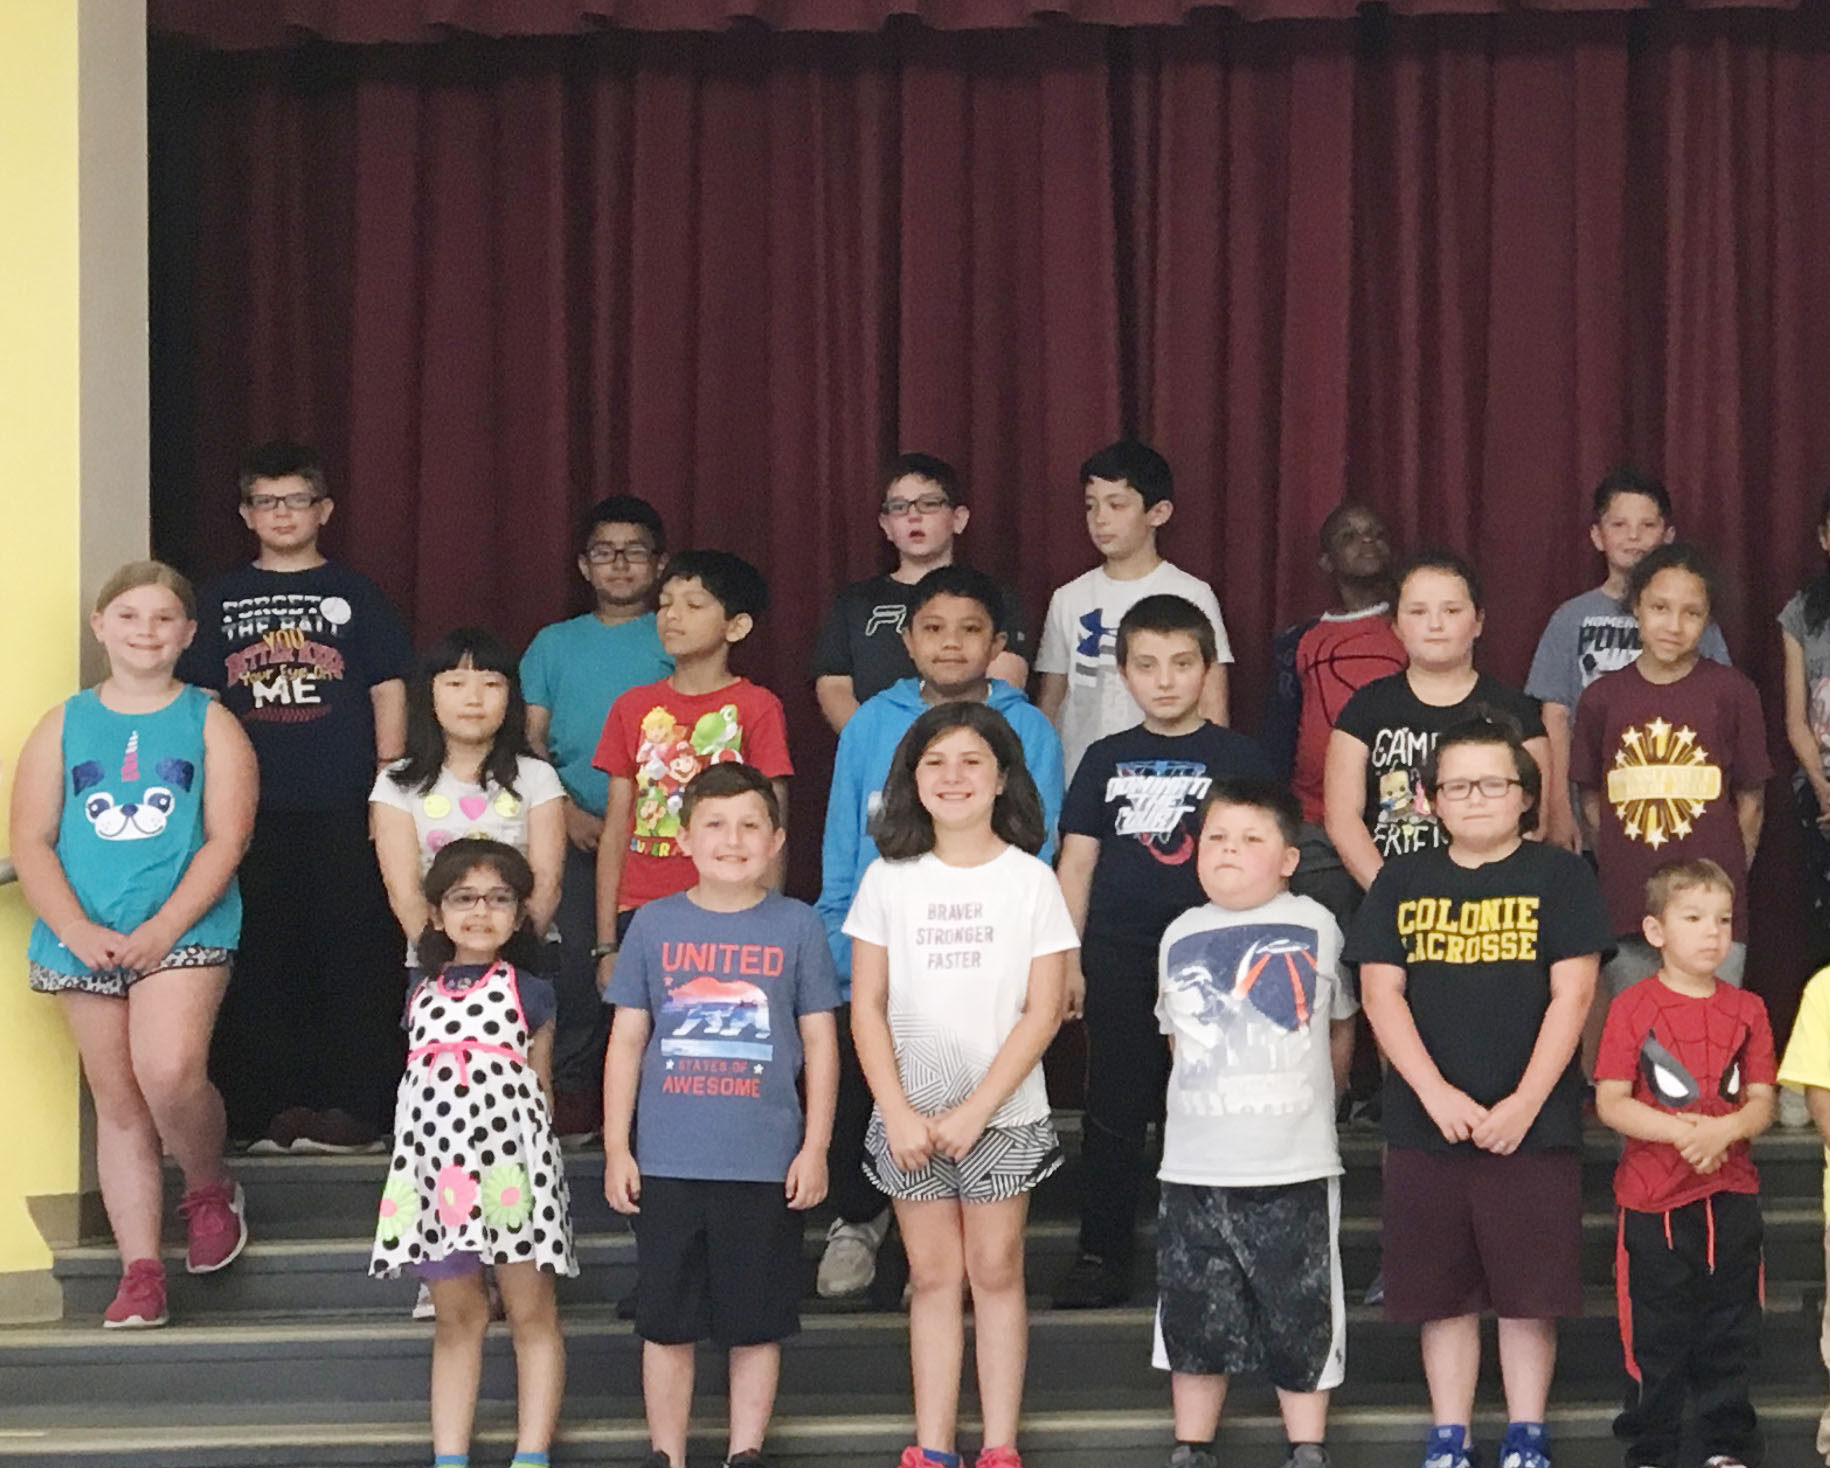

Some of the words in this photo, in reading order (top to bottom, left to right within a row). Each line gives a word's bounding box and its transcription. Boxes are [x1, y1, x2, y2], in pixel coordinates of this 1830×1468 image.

[262, 627, 305, 654] YOU
[1578, 626, 1642, 656] POW
[252, 675, 322, 709] ME
[926, 902, 983, 921] BRAVER
[1397, 895, 1541, 936] COLONIE
[915, 925, 994, 946] STRONGER
[661, 942, 785, 978] UNITED
[926, 950, 982, 970] FASTER
[678, 1058, 727, 1073] STATES
[731, 1061, 748, 1075] OF
[662, 1075, 761, 1099] AWESOME
